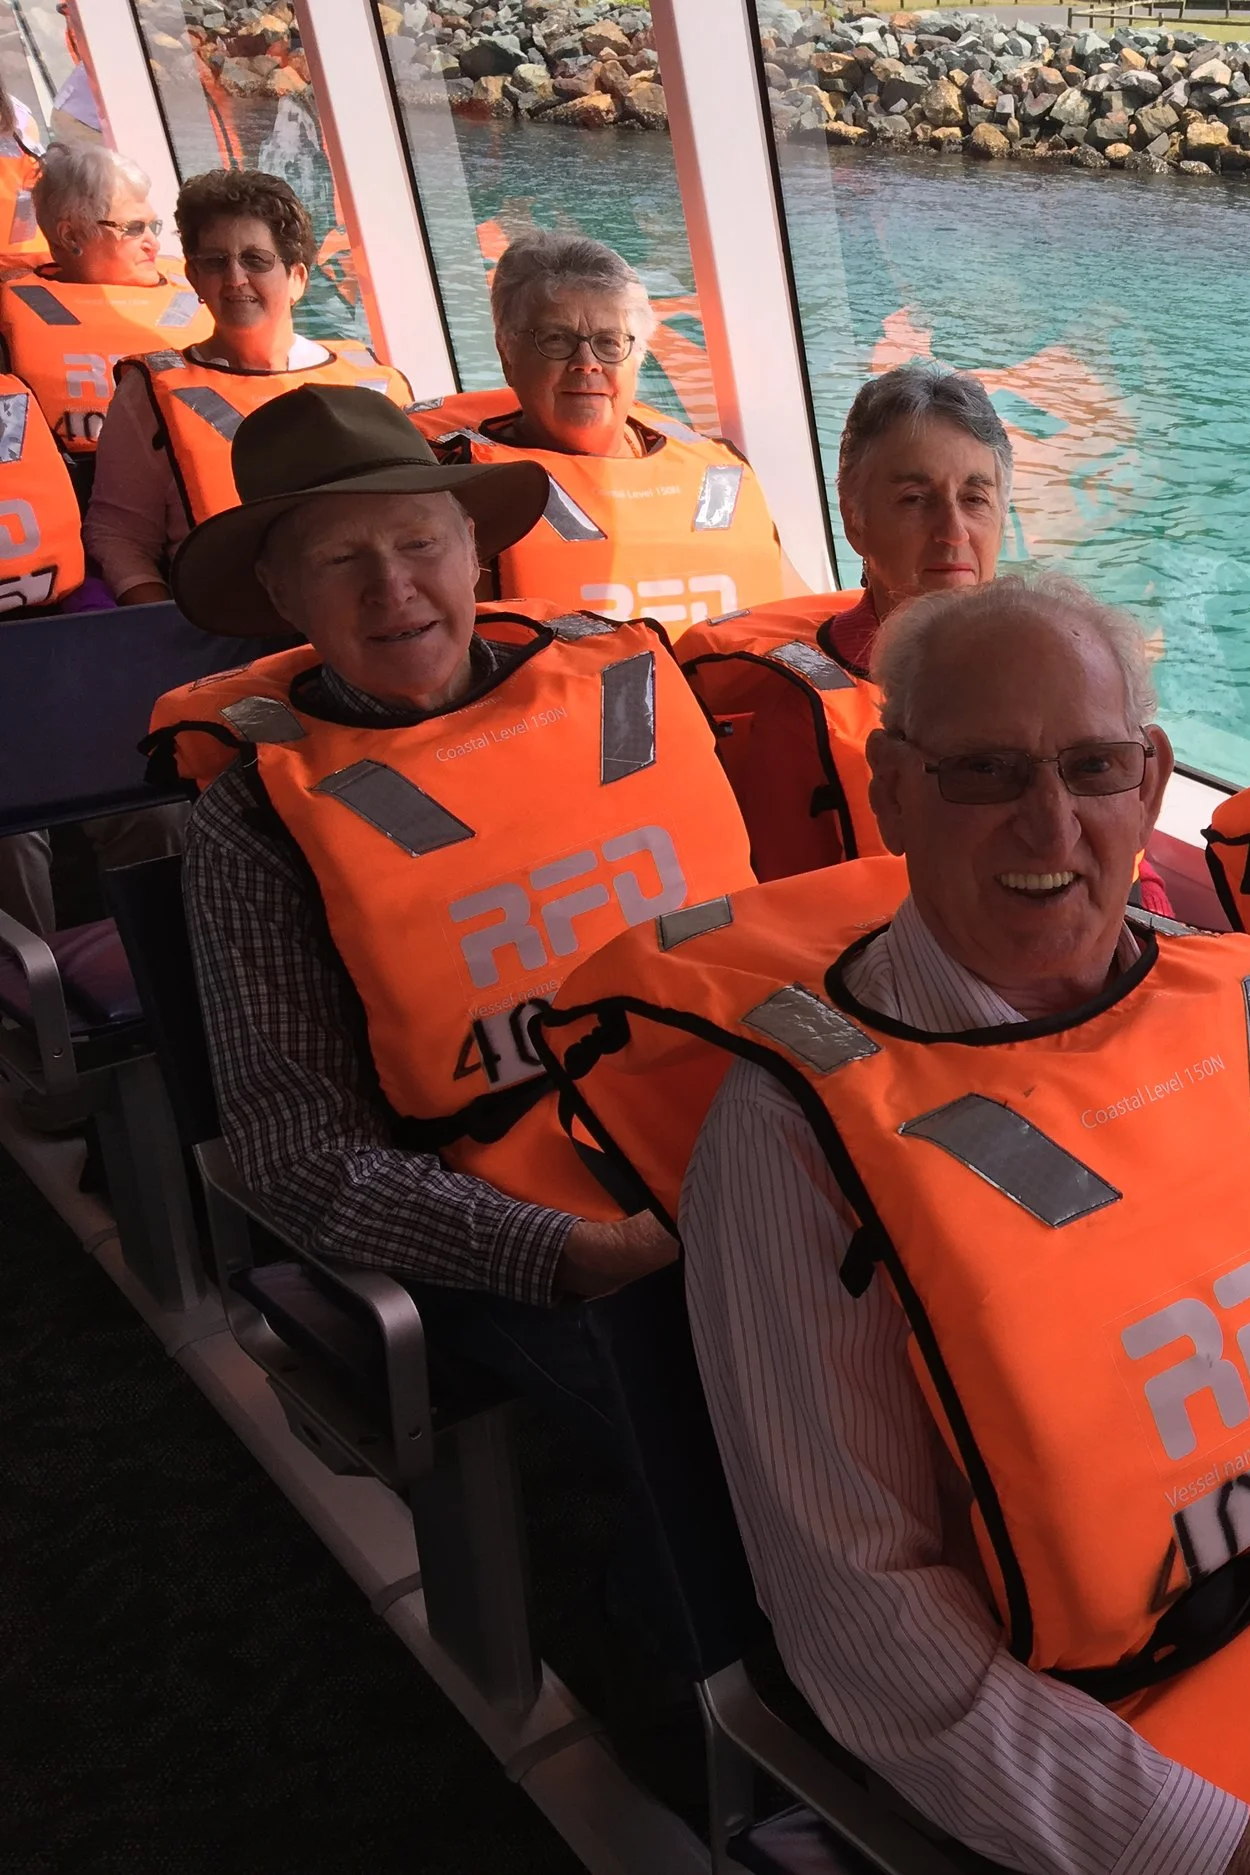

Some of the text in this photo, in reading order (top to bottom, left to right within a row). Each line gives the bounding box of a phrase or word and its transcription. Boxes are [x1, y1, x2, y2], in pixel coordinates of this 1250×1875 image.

[436, 705, 568, 762] Coastal Level 150N
[448, 825, 687, 989] RFD
[1081, 1054, 1226, 1129] Coastal Level 150N
[1164, 1462, 1221, 1509] Vessel
